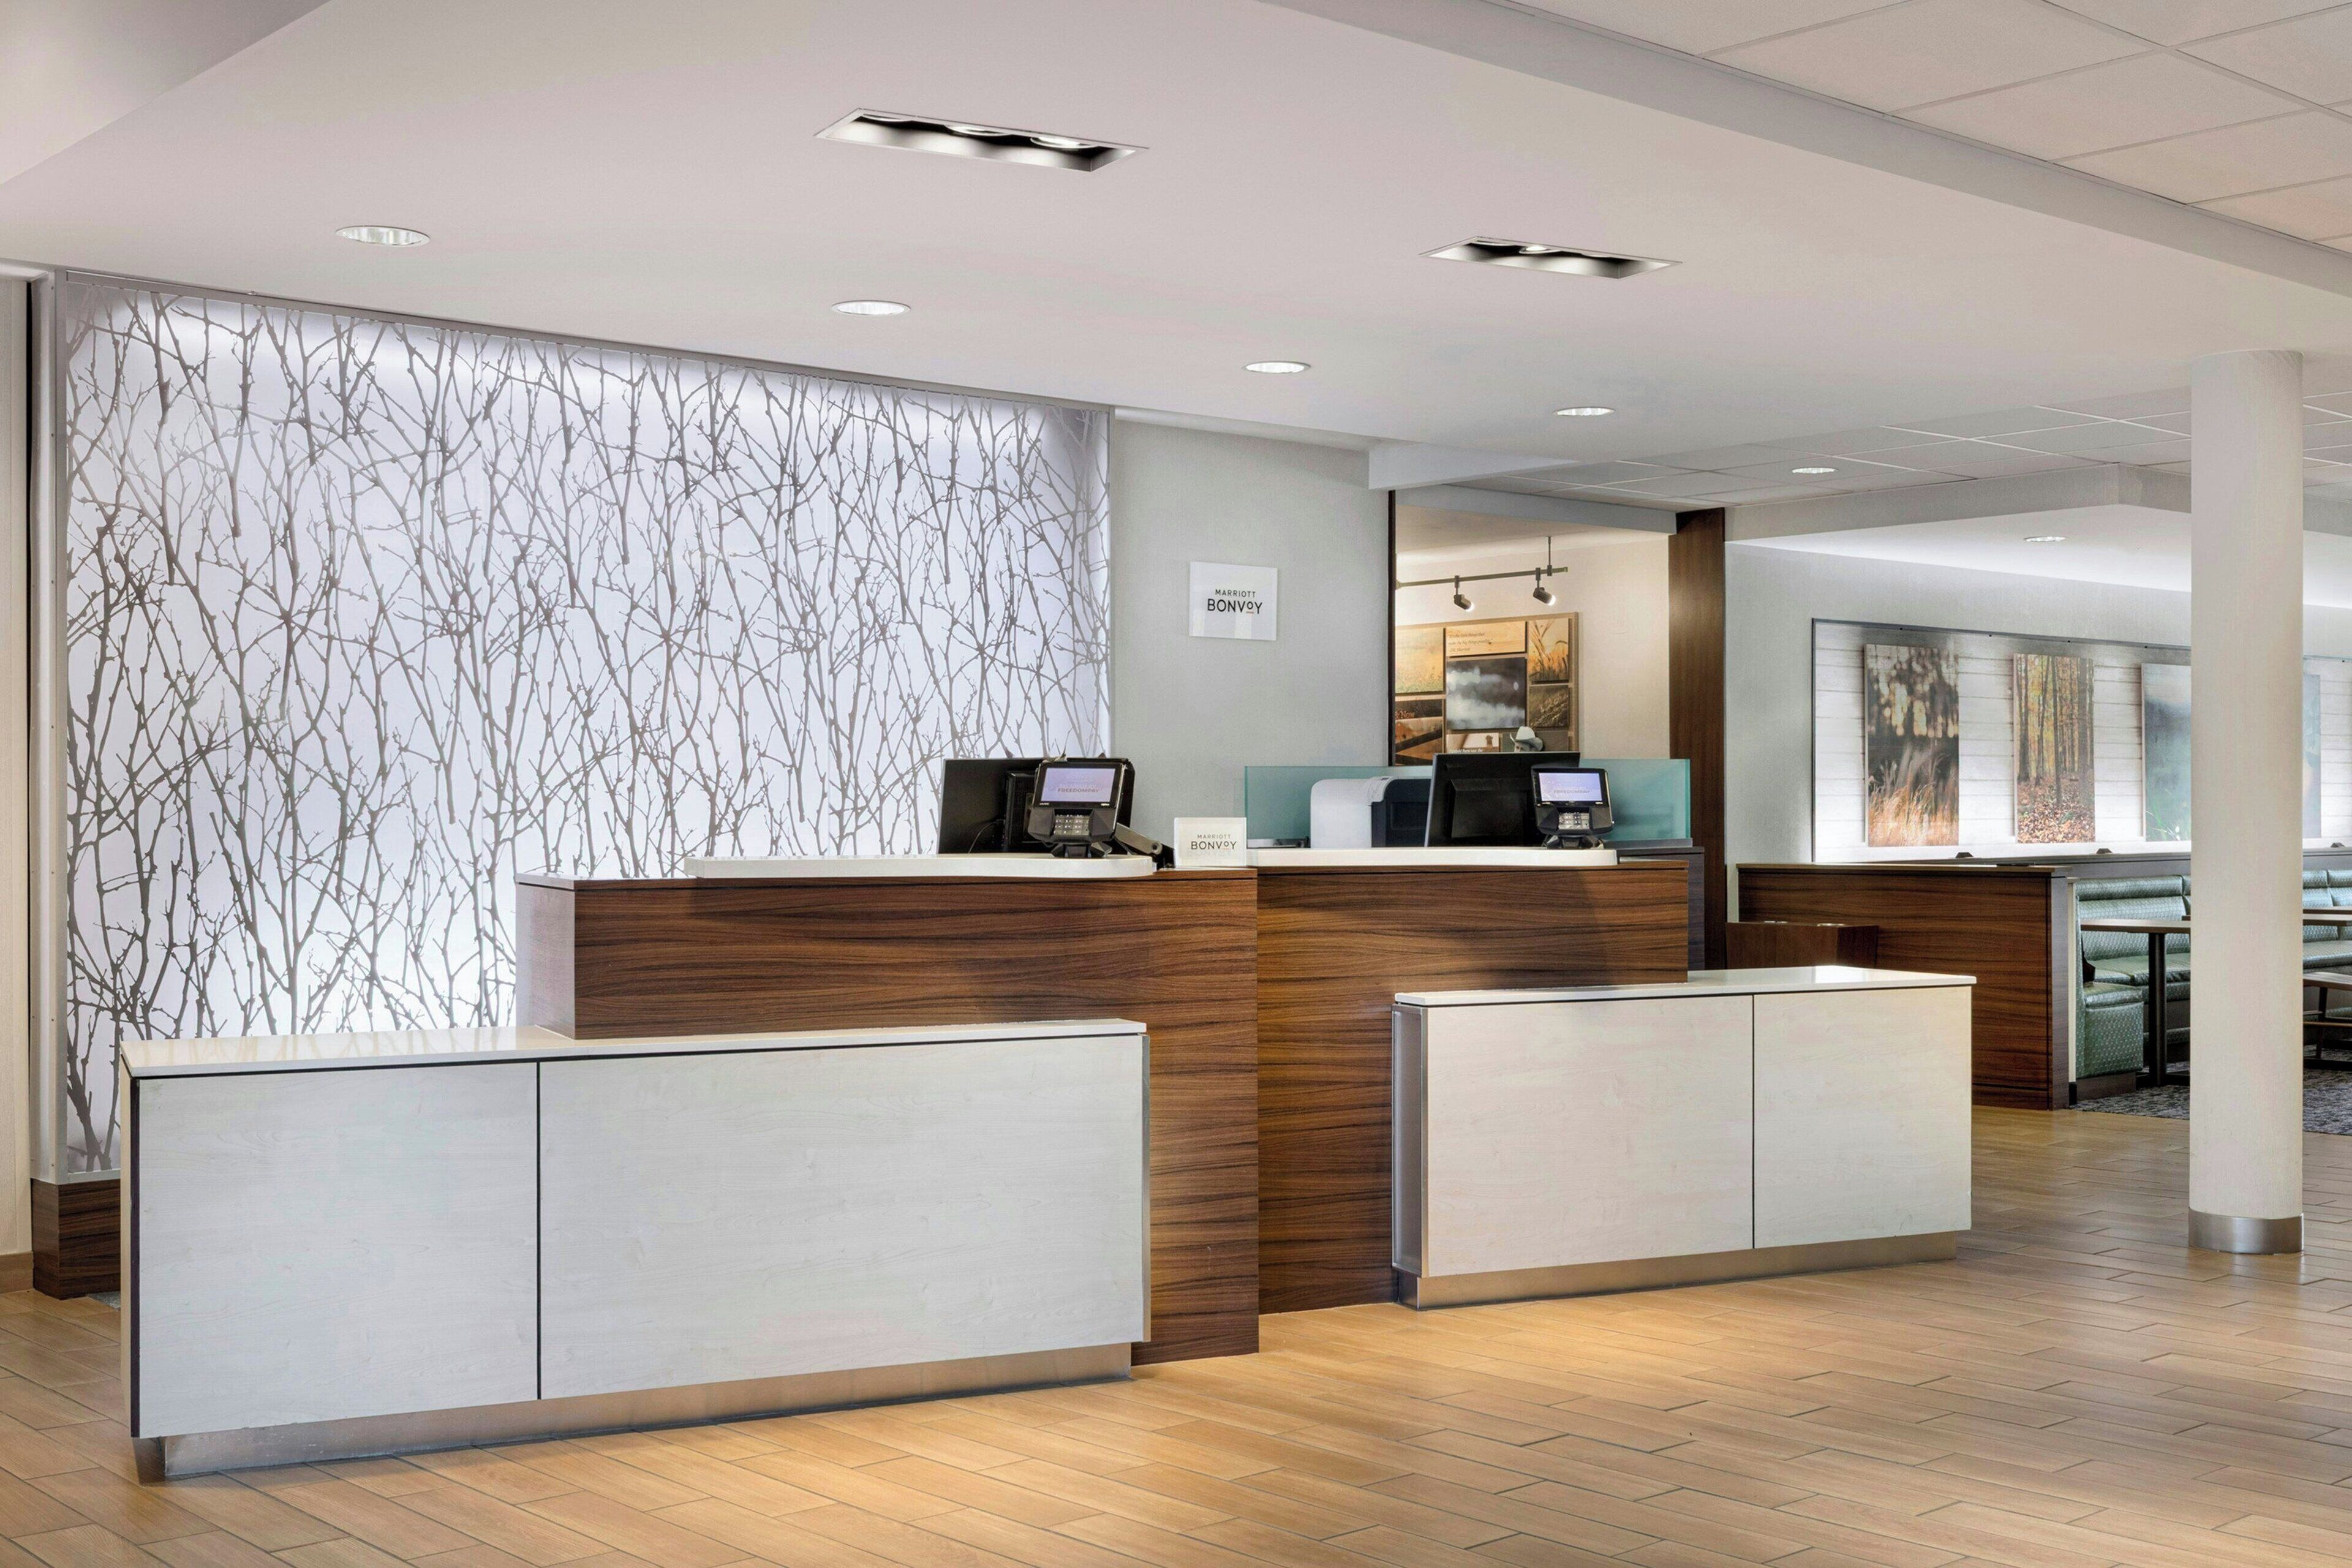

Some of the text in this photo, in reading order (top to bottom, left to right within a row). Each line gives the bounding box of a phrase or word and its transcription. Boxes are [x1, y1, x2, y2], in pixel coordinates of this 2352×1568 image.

[1215, 589, 1256, 598] MARRIOTT
[1207, 598, 1263, 614] BONVOY
[1191, 841, 1237, 850] BONVOY
